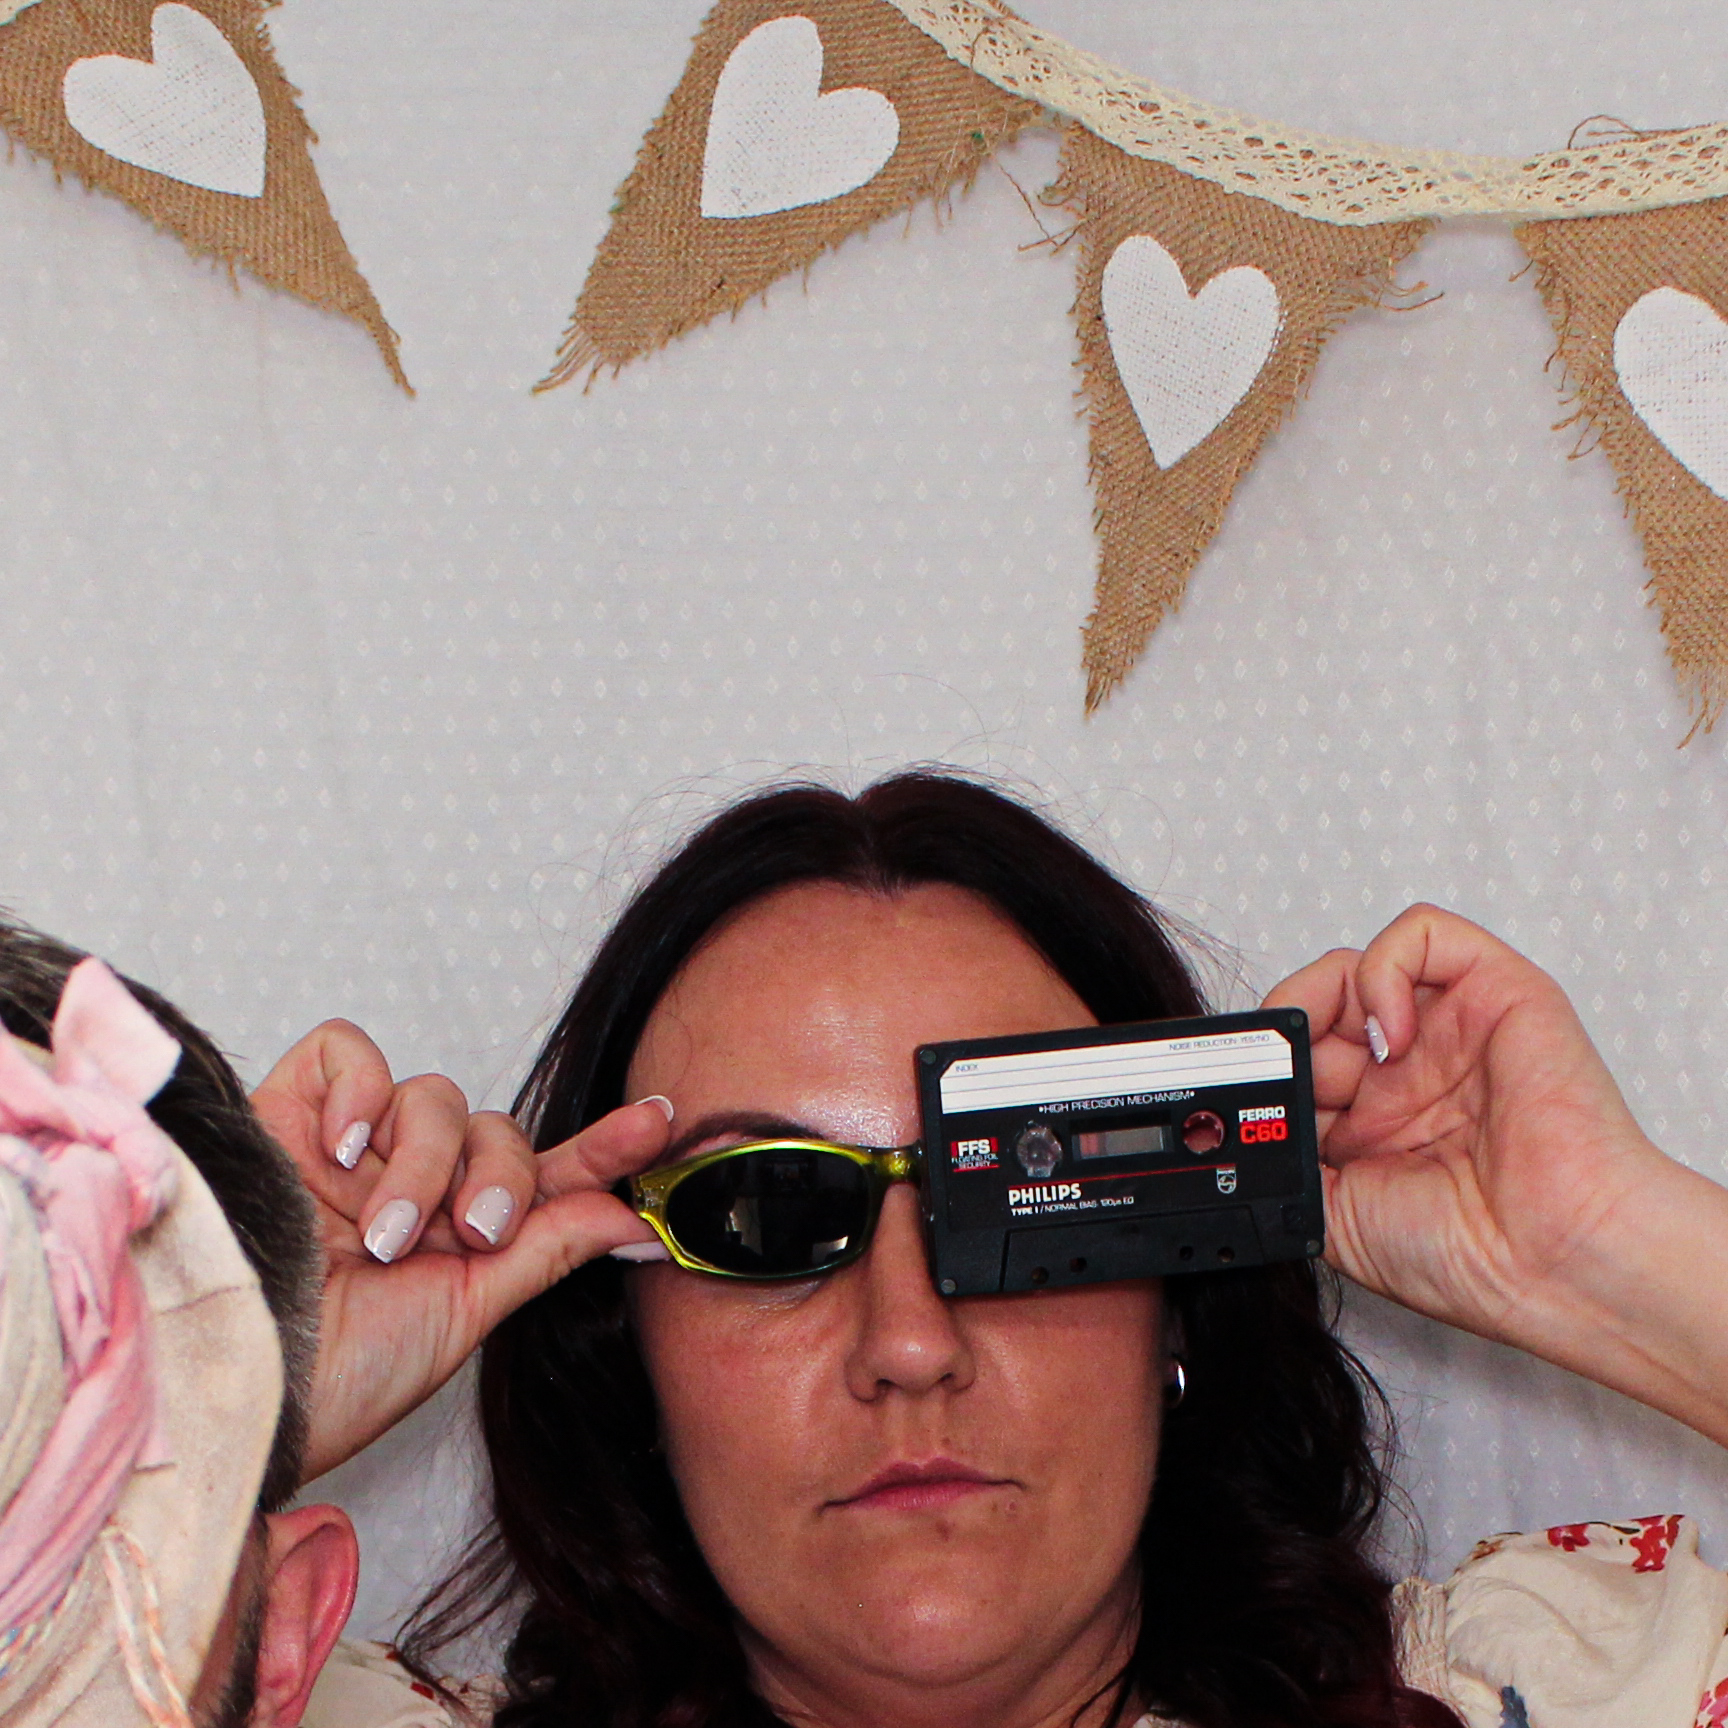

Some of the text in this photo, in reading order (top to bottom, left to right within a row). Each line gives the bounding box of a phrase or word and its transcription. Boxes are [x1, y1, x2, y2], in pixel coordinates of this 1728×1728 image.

[1193, 1037, 1237, 1049] REDUCTION
[1043, 1090, 1191, 1114] HIGH PRECISION MECHANISM
[1238, 1105, 1286, 1123] FERRO
[1240, 1121, 1288, 1144] C60
[957, 1138, 991, 1157] FFS
[1008, 1182, 1082, 1206] PHILIPS
[1011, 1206, 1033, 1216] TYPE
